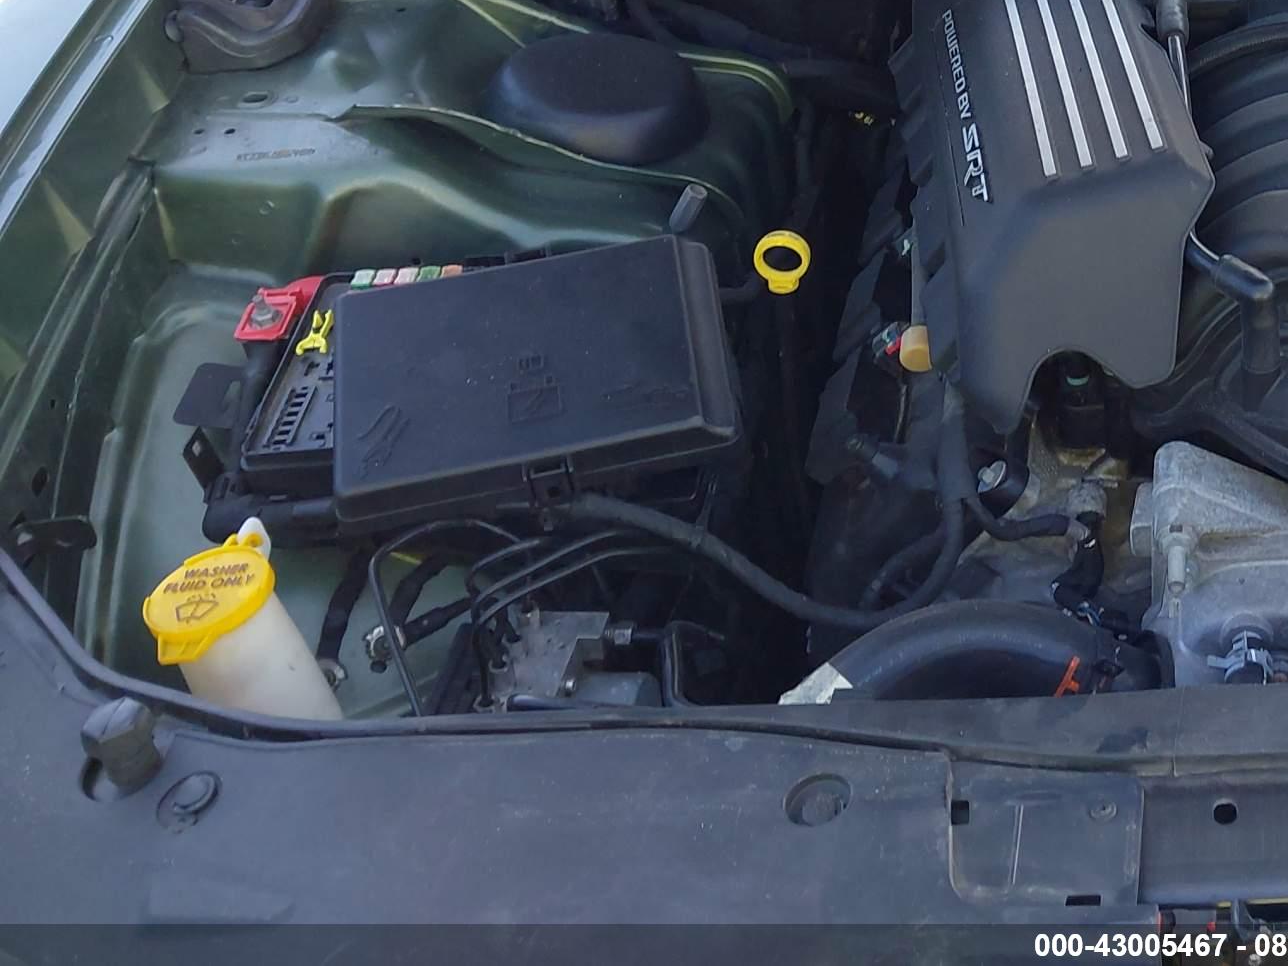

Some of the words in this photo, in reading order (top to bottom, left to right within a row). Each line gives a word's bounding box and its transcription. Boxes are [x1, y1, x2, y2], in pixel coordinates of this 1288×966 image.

[942, 9, 966, 93] POWERED
[957, 92, 972, 119] BY
[962, 122, 989, 202] SRT
[163, 579, 206, 594] FLUID
[211, 573, 255, 589] ONLY
[184, 562, 249, 580] WASHER
